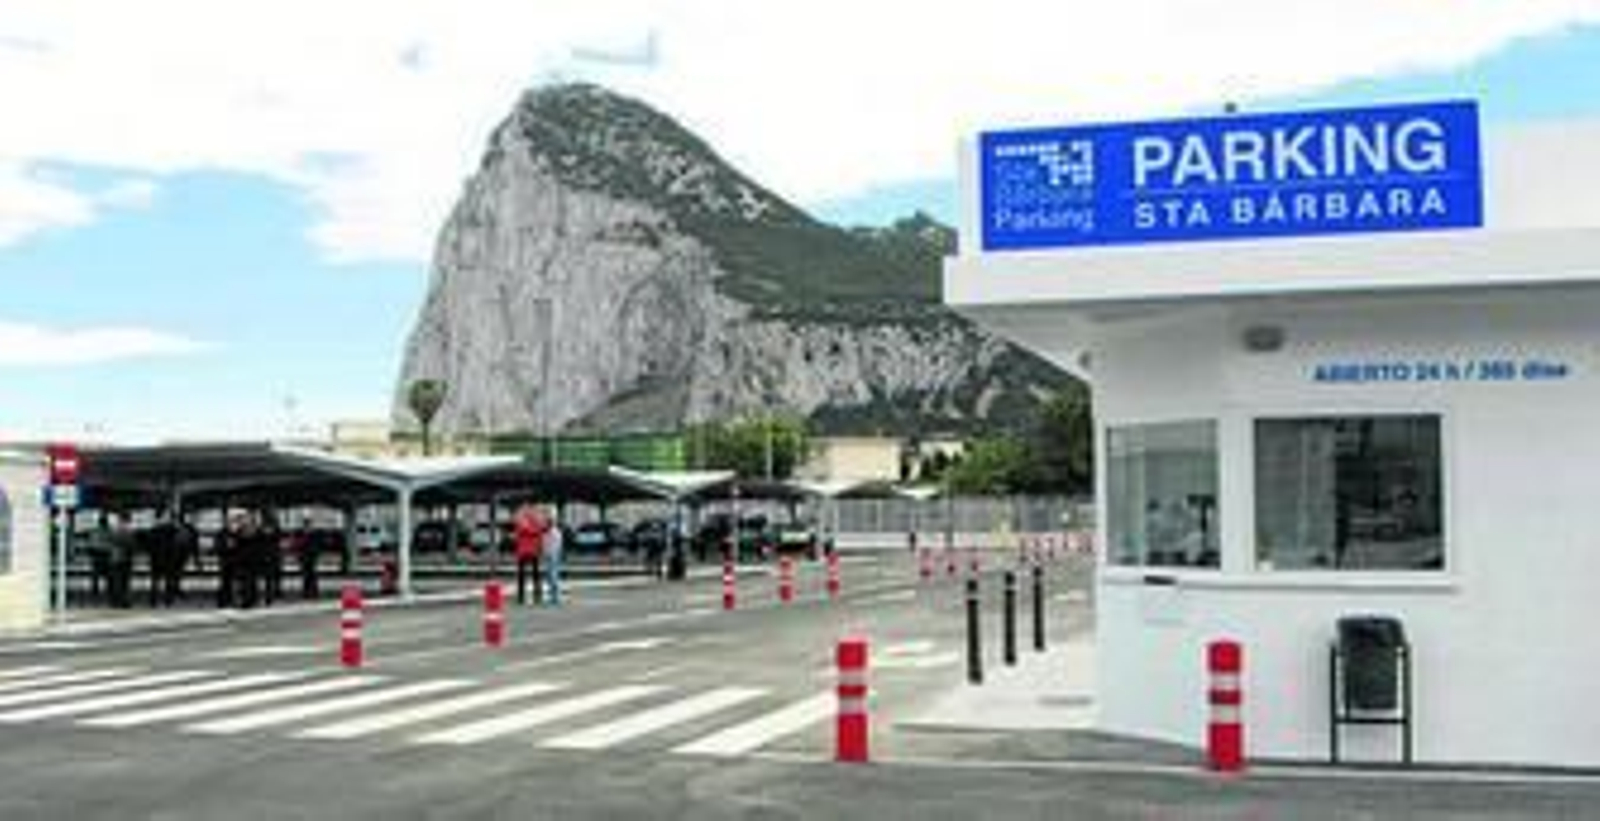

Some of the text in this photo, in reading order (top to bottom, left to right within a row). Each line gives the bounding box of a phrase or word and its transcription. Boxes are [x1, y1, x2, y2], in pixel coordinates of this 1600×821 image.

[1133, 119, 1447, 186] PARKING
[994, 207, 1095, 232] Parking
[1134, 187, 1447, 228] STA BÁRBARA
